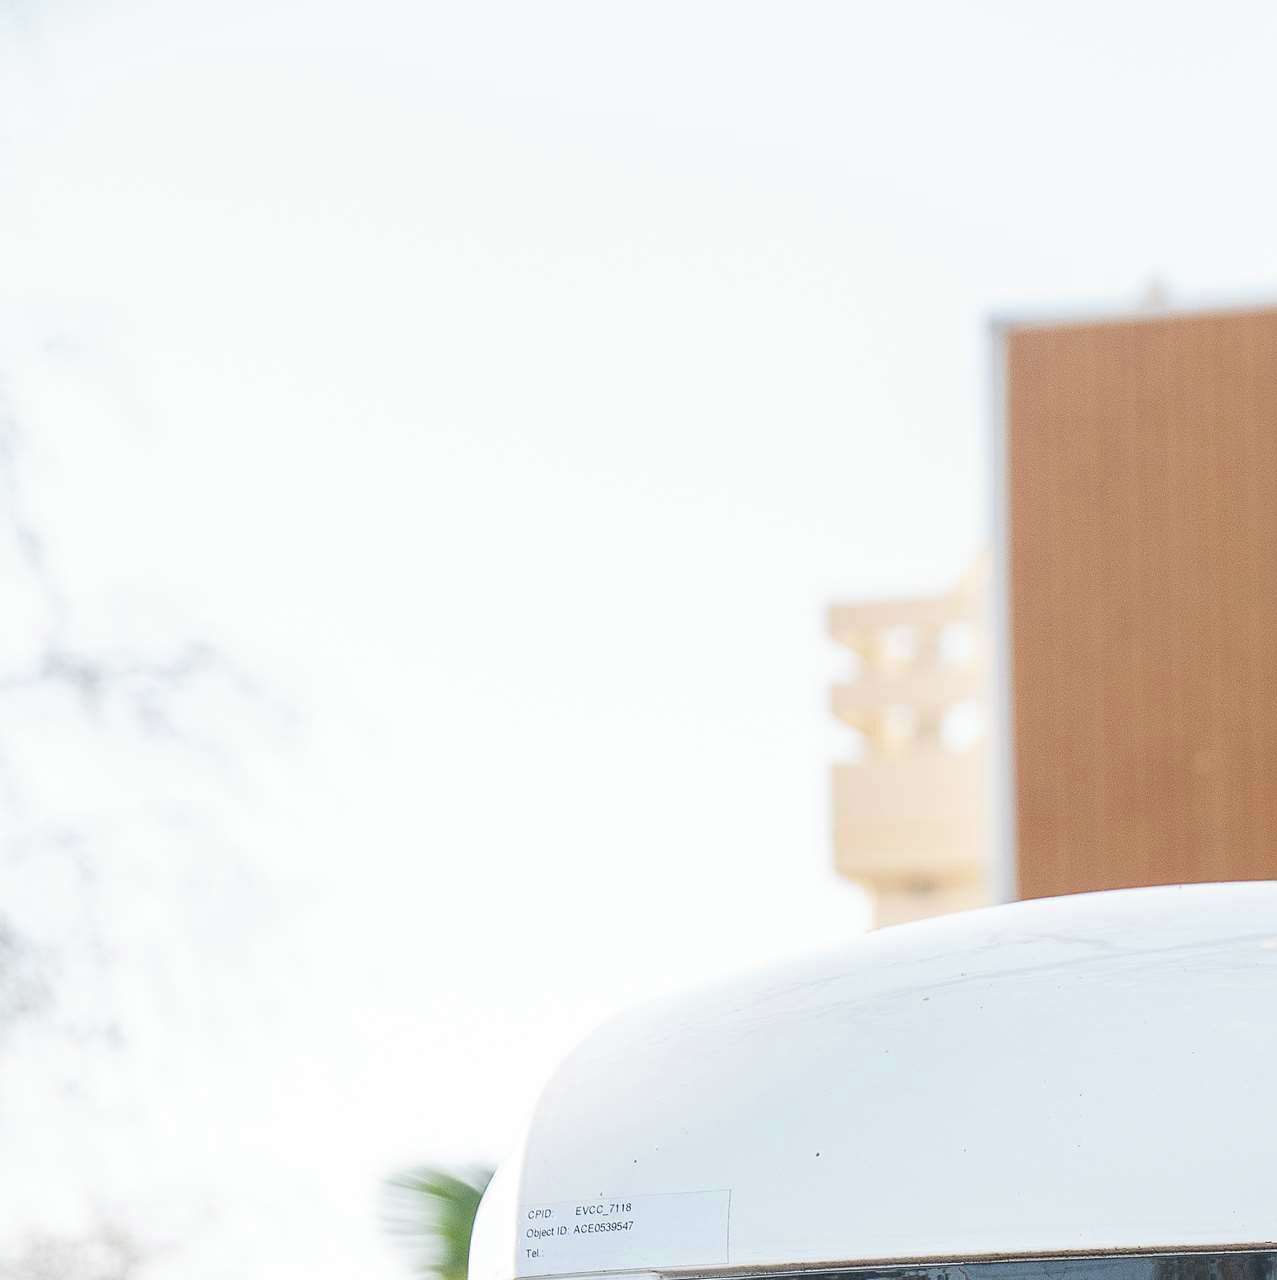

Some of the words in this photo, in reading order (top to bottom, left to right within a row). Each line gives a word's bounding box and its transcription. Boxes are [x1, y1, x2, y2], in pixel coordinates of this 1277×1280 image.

[575, 1203, 632, 1216] EVCC_7118
[526, 1227, 554, 1239] Object
[573, 1220, 634, 1234] ACE0539547
